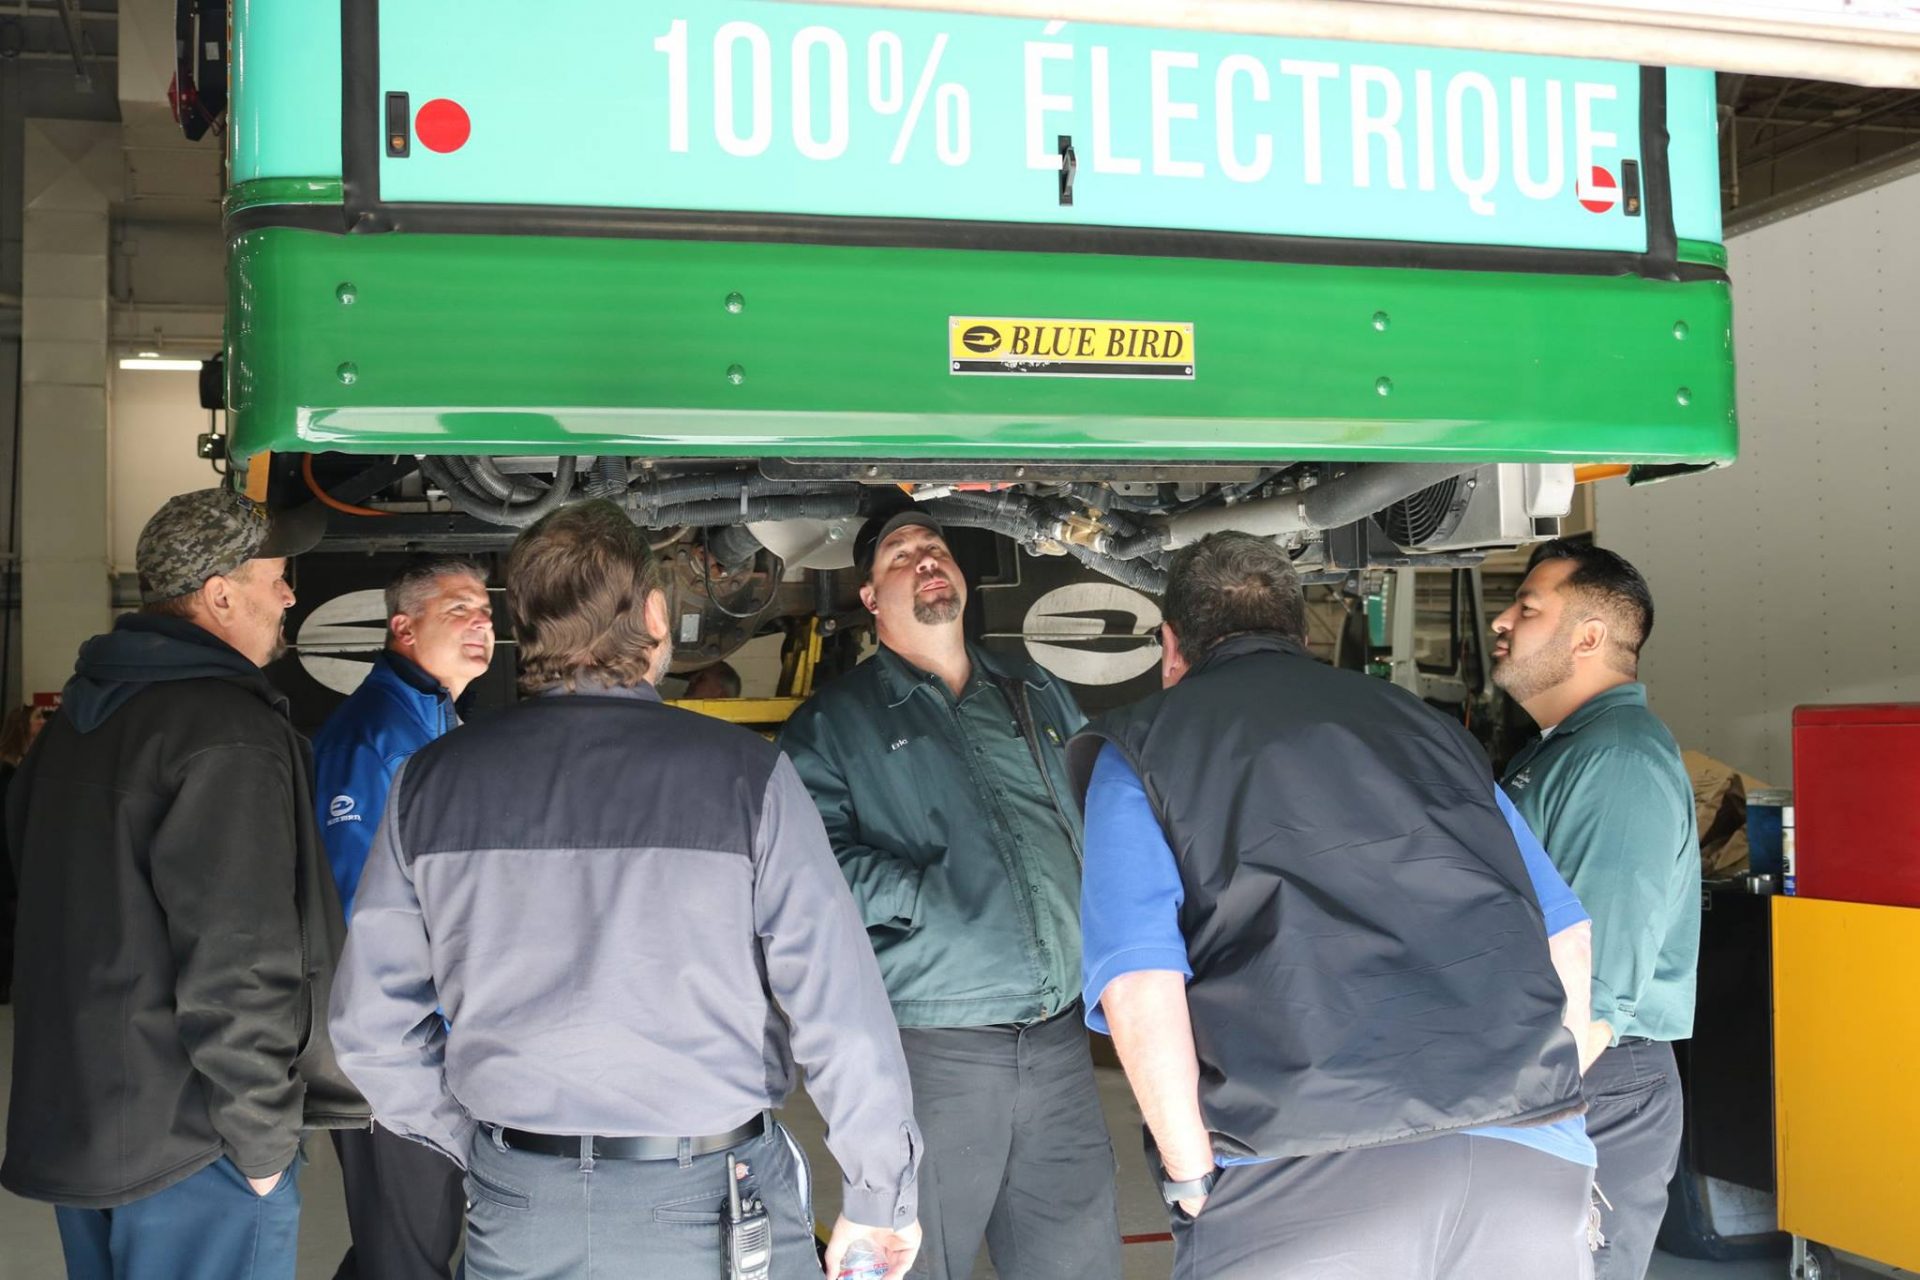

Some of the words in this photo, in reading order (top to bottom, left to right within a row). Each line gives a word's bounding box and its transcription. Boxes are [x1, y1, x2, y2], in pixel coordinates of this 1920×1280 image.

[653, 18, 971, 167] 100%
[1024, 20, 1623, 216] ÉLECTRIQUE
[1011, 326, 1096, 357] BLUE
[1105, 328, 1184, 359] BIRD
